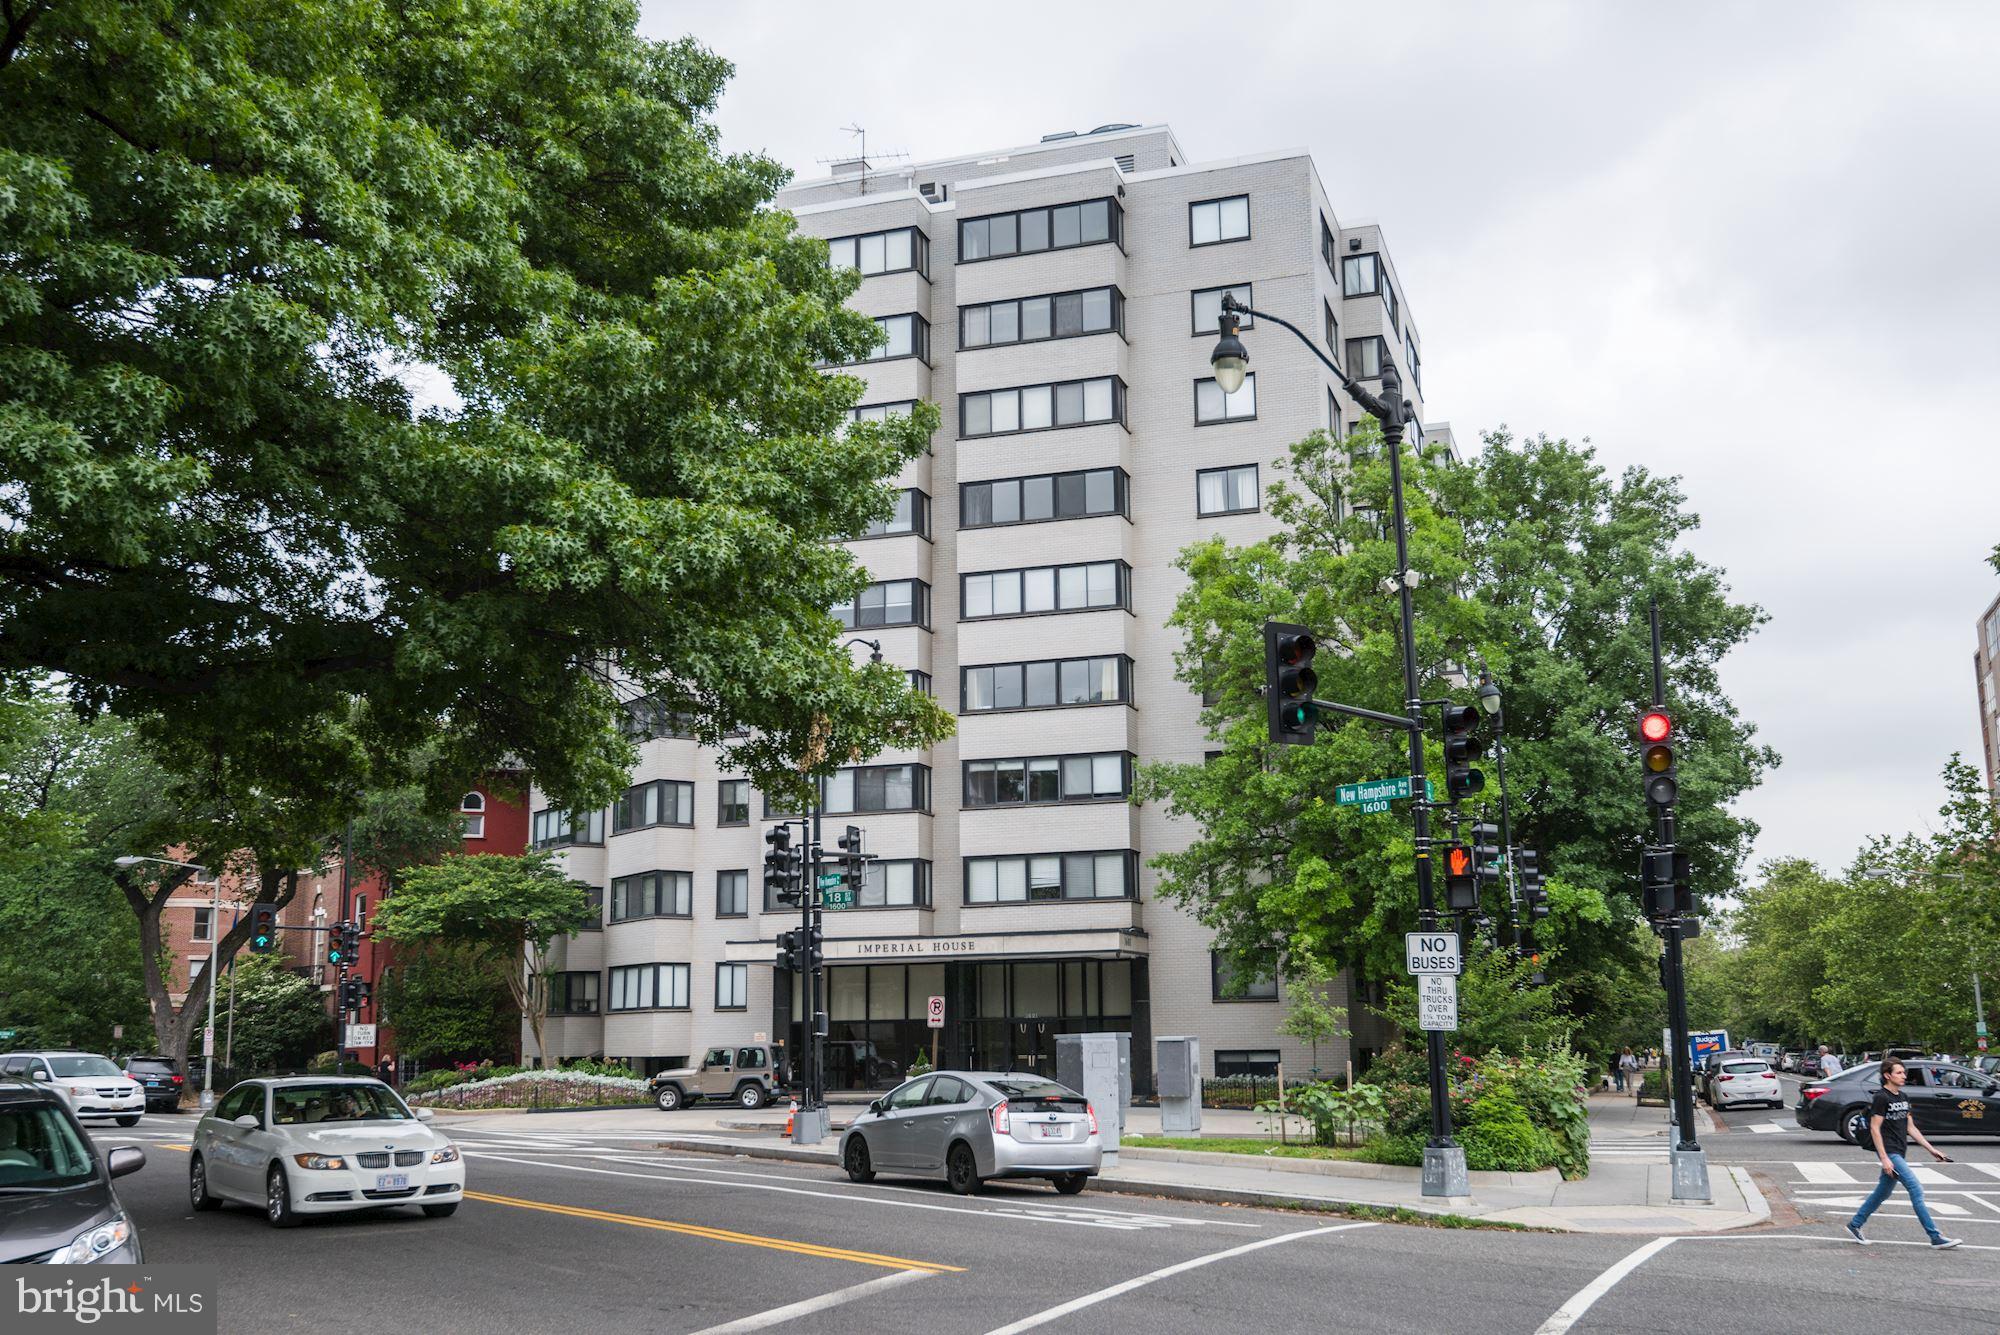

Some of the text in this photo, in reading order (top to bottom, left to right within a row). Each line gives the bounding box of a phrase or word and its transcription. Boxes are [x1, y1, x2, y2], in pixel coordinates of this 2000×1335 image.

[1340, 788, 1356, 802] New
[1358, 782, 1396, 800] Hampshire
[1363, 801, 1388, 813] 1600
[829, 892, 842, 902] 18
[858, 941, 975, 953] IMPERIAL HOUSE
[1421, 938, 1446, 952] NO
[1412, 956, 1455, 969] BUSES
[1431, 977, 1442, 986] NO
[1427, 986, 1447, 995] THRU
[1422, 995, 1453, 1004] TRUCKS
[1427, 1004, 1448, 1013] OVER
[1695, 1035, 1719, 1044] Budget
